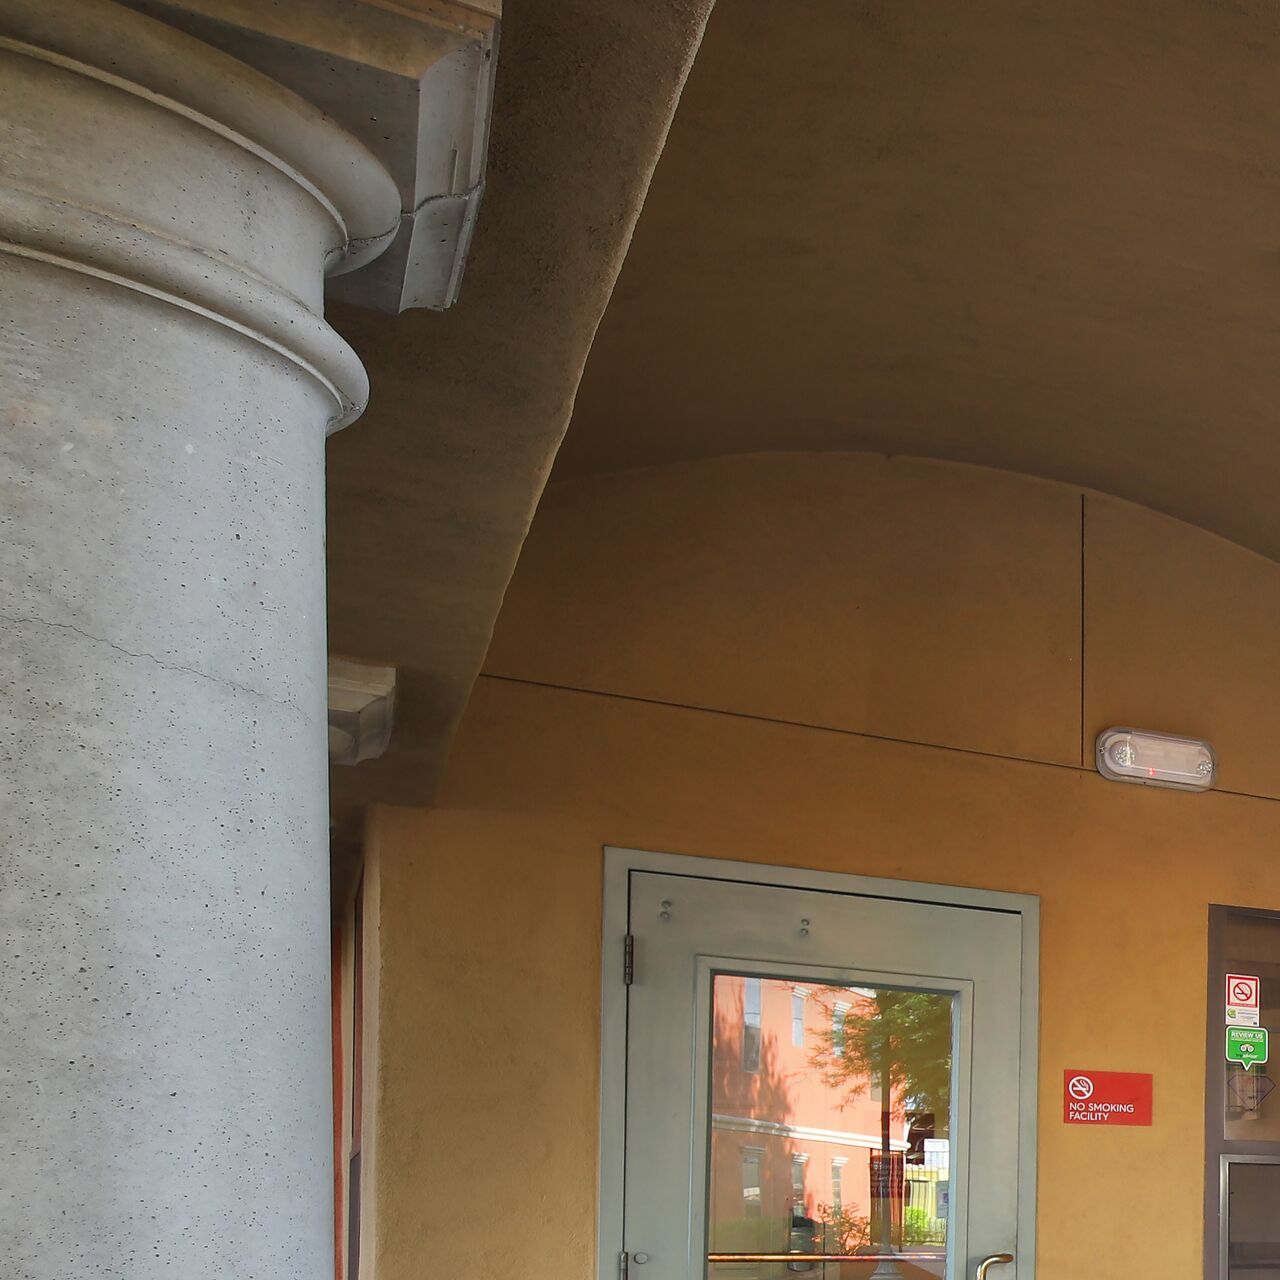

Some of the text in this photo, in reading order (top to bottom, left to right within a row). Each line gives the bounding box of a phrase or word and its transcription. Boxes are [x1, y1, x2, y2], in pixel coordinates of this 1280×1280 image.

[1069, 1102, 1134, 1113] NO SMOKING
[1069, 1112, 1109, 1121] FACILITY
